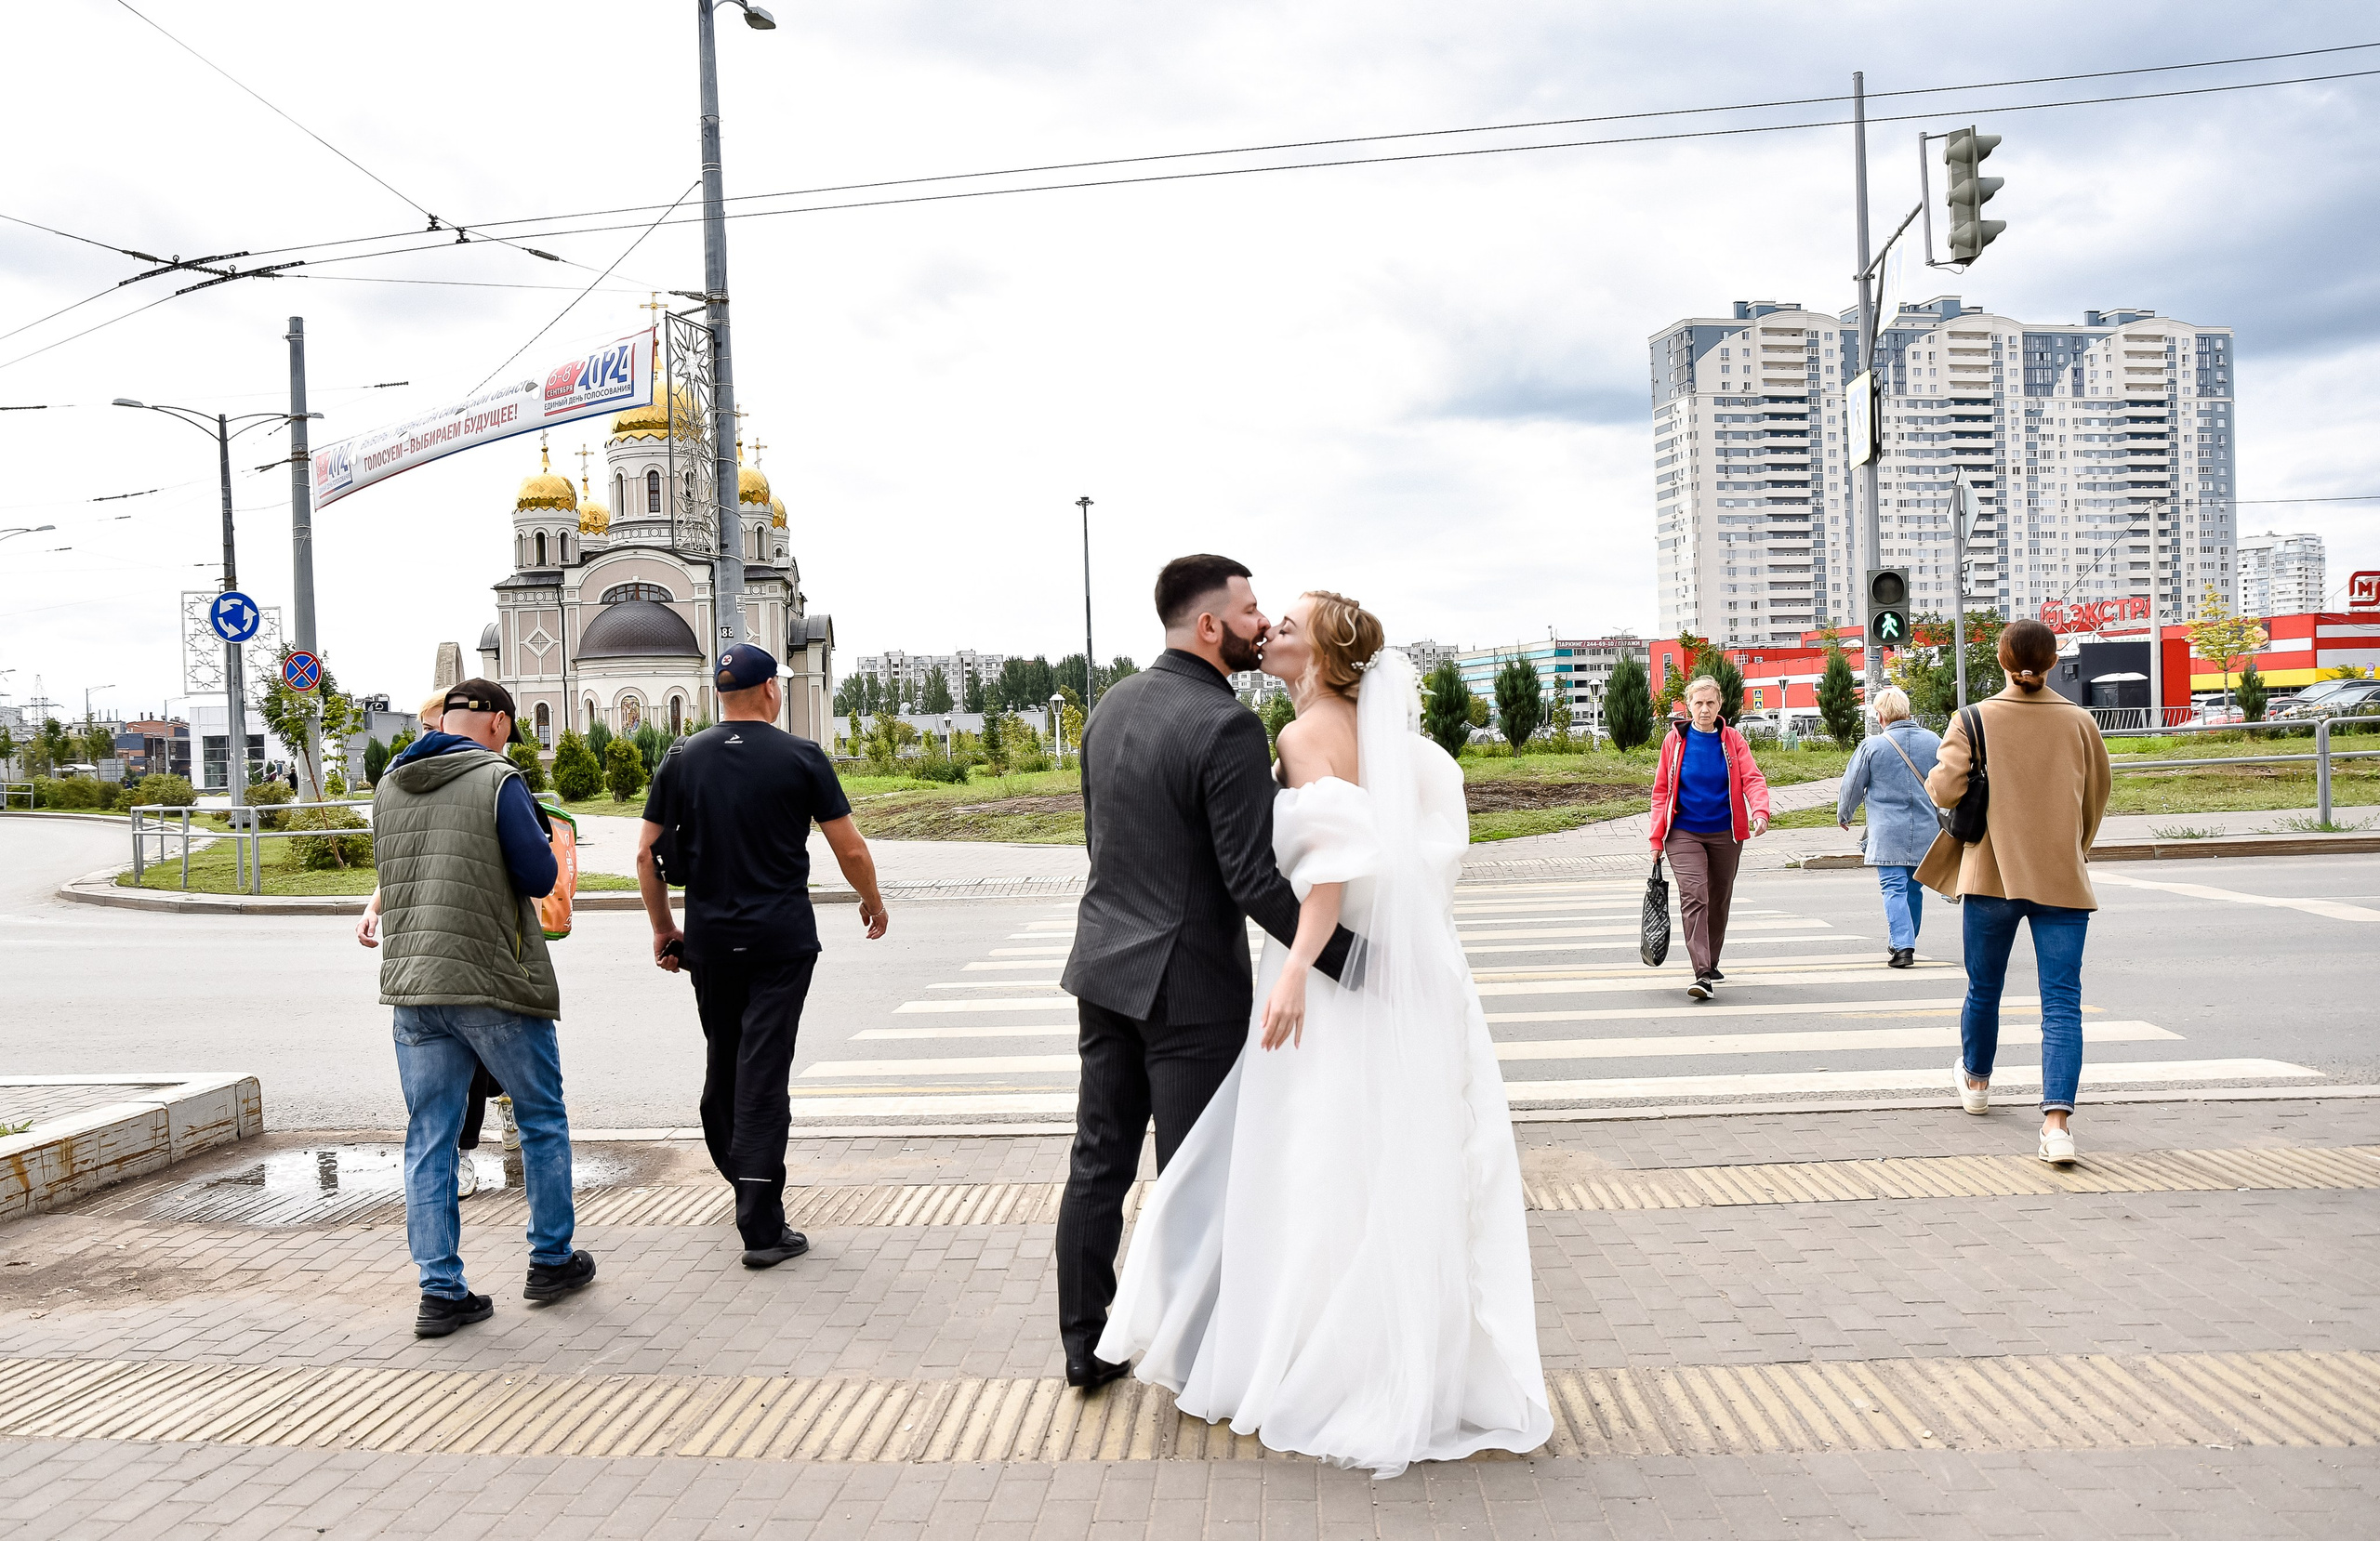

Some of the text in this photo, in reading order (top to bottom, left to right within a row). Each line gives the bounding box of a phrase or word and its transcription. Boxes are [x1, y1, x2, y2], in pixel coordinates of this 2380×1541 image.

[549, 345, 629, 392] 6-8 2024
[544, 384, 631, 411] ЕДИНЫЙ ДЕНЬ ГОЛОСОВАНИЯ
[547, 384, 574, 398] СЕНТЯБРЯ
[464, 402, 519, 434] БУДУЩЕЕ!
[721, 627, 734, 638] 88
